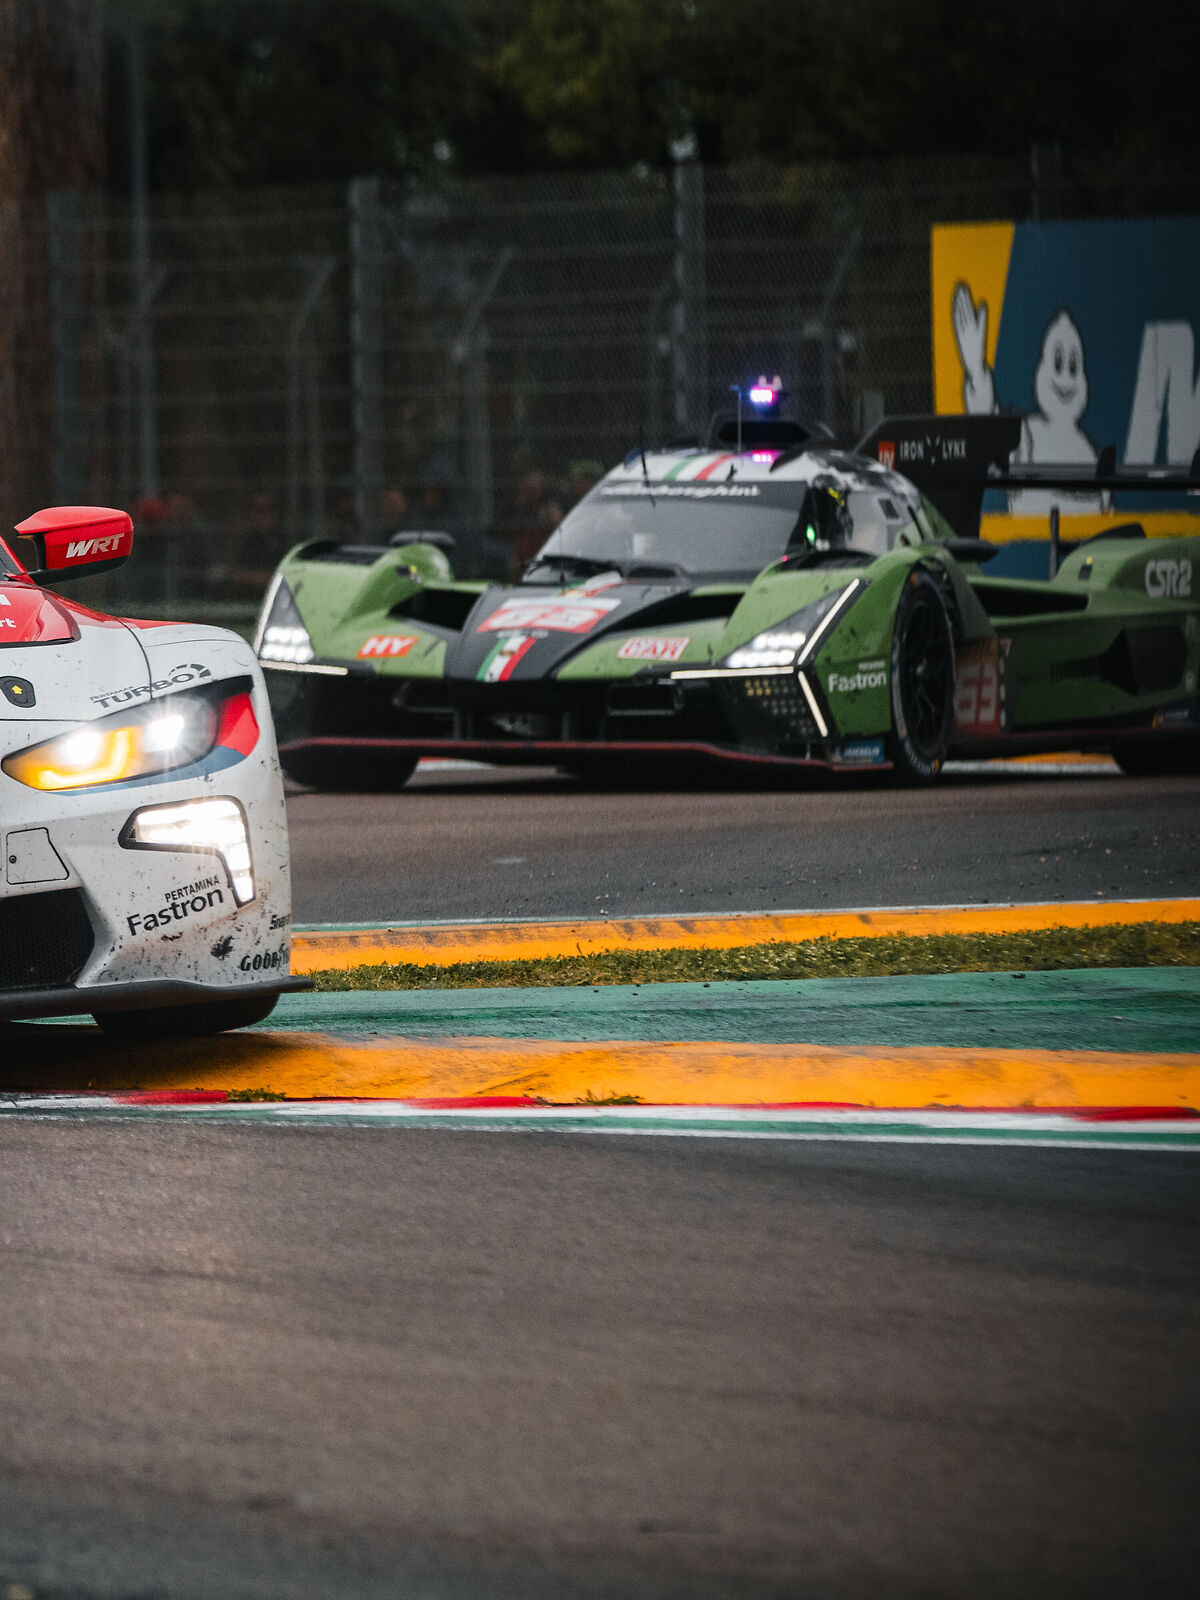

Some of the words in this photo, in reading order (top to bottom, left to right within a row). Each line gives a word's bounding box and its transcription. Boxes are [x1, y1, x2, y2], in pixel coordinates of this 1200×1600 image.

[900, 440, 924, 460] IRON
[942, 440, 966, 459] LYNX
[66, 533, 125, 558] WRT
[1145, 559, 1192, 597] CSR2
[361, 637, 415, 655] HY
[93, 673, 195, 708] TURBO
[827, 672, 887, 693] Fastron
[165, 875, 220, 903] PERTAMINA
[126, 888, 224, 937] Fastron
